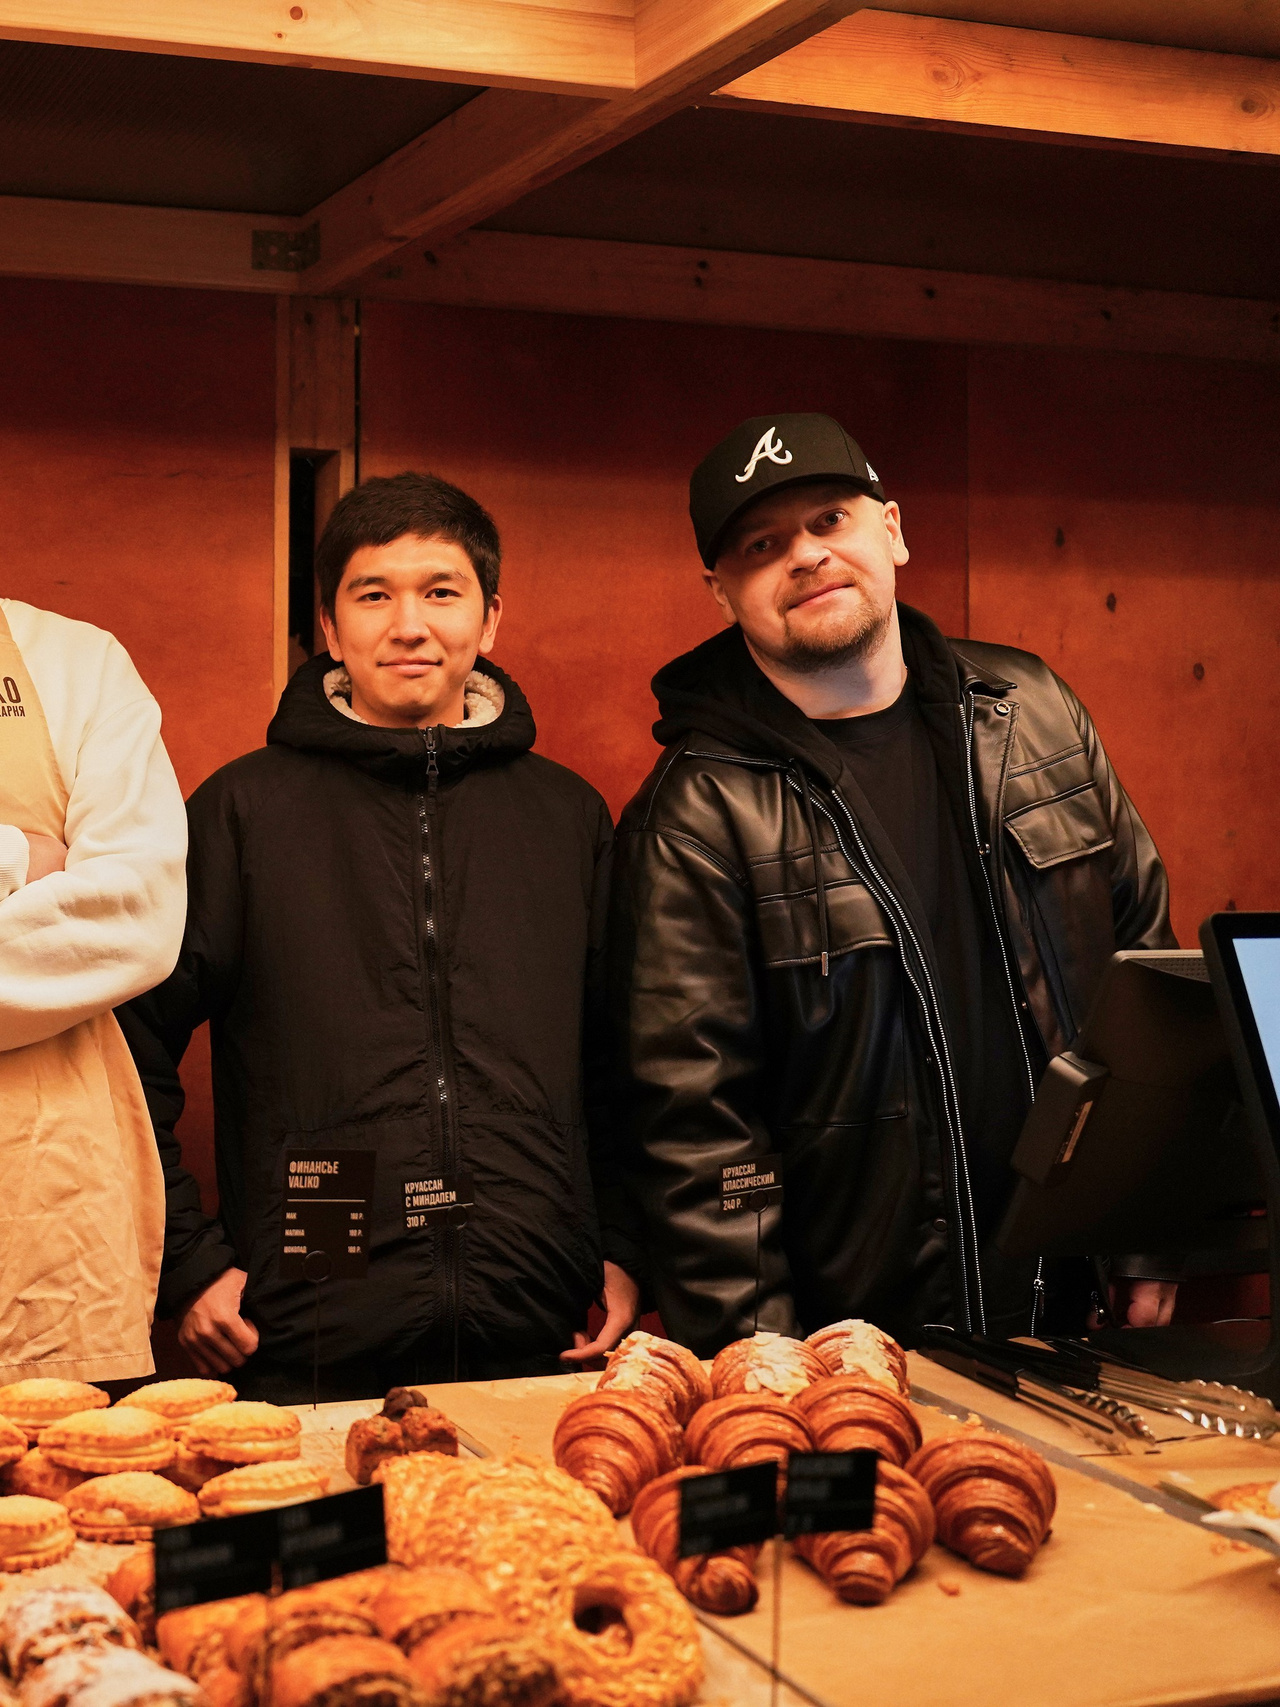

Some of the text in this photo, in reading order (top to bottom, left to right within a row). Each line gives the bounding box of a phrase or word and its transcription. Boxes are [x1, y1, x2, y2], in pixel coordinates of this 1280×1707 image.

[735, 426, 793, 483] A
[289, 1160, 339, 1175] ФИНАНСЬЕ
[722, 1163, 756, 1179] КРУАССАН
[288, 1175, 320, 1189] VALIKO
[404, 1178, 443, 1194] КРУАССАН
[722, 1171, 775, 1191] КЛАССИЧЕСКИЙ
[405, 1190, 457, 1208] С МИНДАЛЕМ
[723, 1198, 736, 1211] 240
[406, 1214, 428, 1228] 310 Р.
